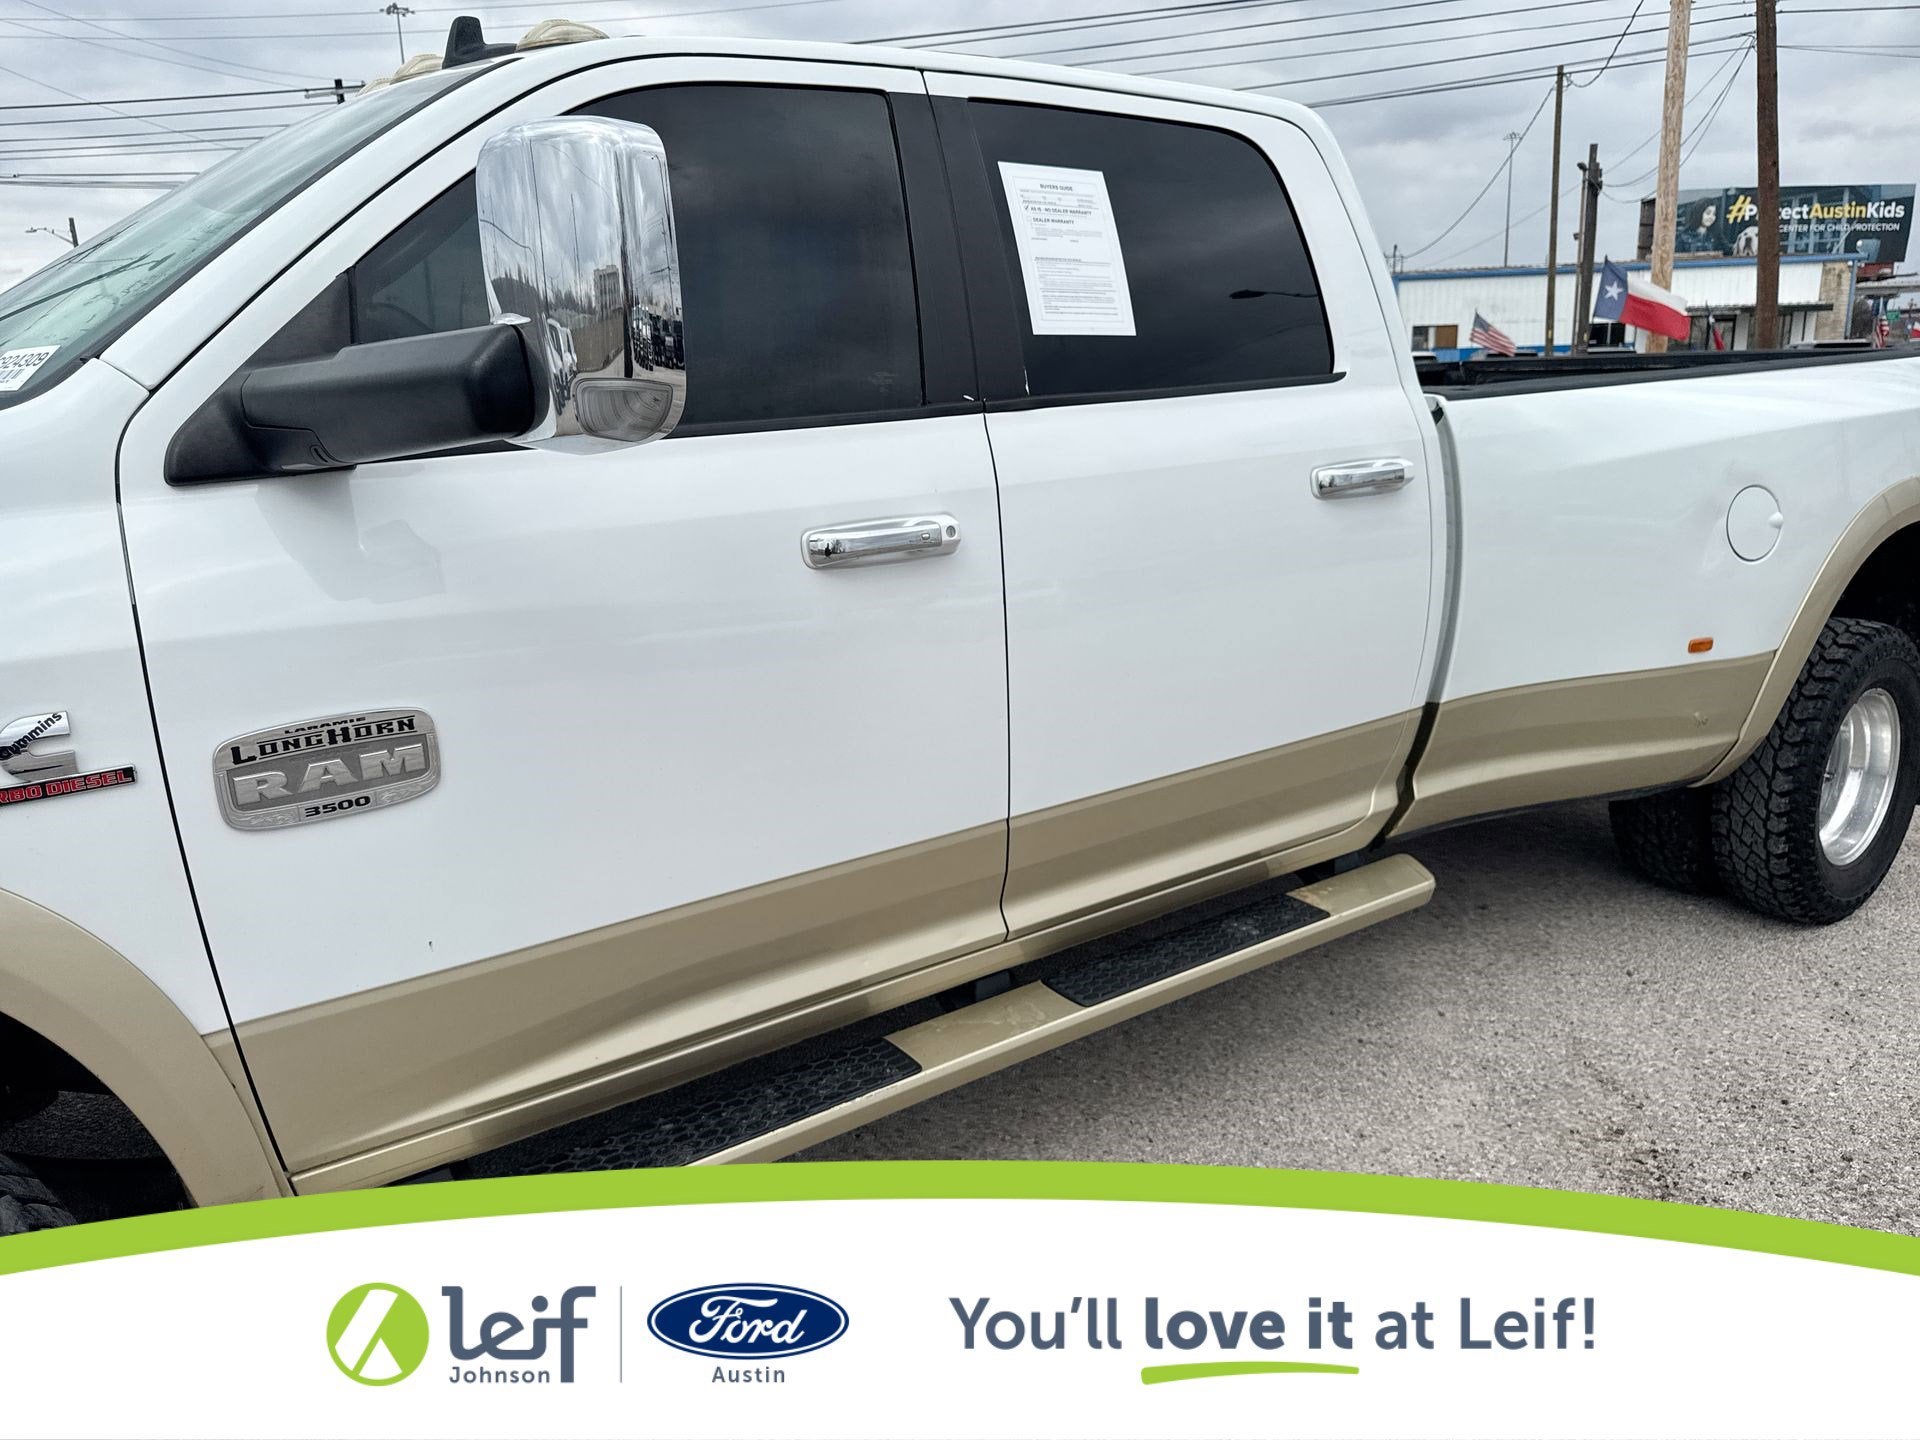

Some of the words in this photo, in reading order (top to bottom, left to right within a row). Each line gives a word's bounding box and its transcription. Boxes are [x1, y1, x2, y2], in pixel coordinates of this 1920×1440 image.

[284, 716, 366, 735] LARAMIE
[46, 769, 132, 797] DIESEL
[233, 743, 427, 806] RAM
[304, 795, 371, 818] 3500
